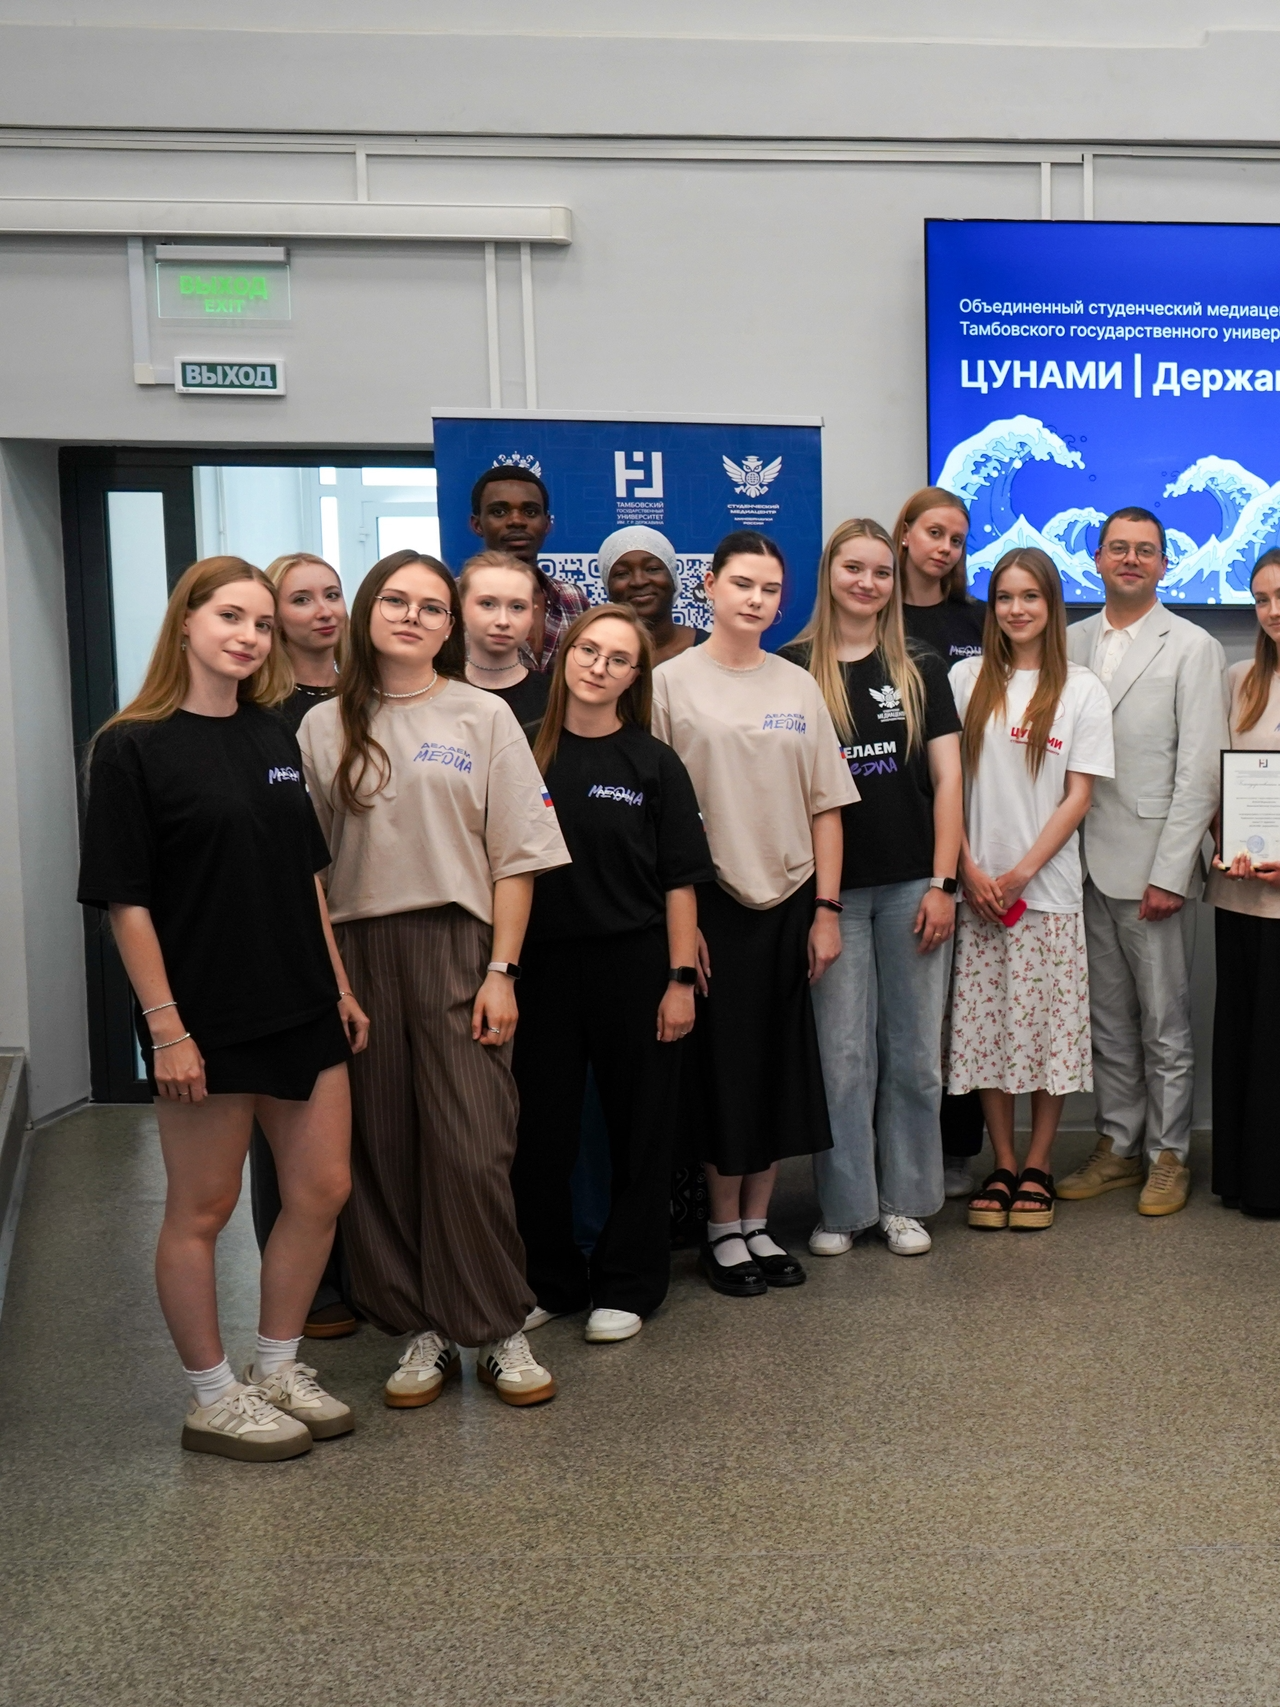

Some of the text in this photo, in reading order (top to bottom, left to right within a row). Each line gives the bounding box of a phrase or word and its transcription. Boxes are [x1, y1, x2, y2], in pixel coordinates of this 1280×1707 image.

[180, 275, 268, 300] ВЫХОД
[204, 299, 245, 313] EXIT
[959, 298, 1084, 316] Объединенный
[1088, 301, 1203, 319] студенческий
[959, 321, 1066, 337] Тамбовского
[1069, 324, 1218, 341] государственного
[185, 364, 273, 387] ВЫХОД
[960, 358, 1124, 395] ЦУНАМИ
[1010, 726, 1063, 750] ЦУМИ
[843, 741, 897, 760] ЕЛАЕМ
